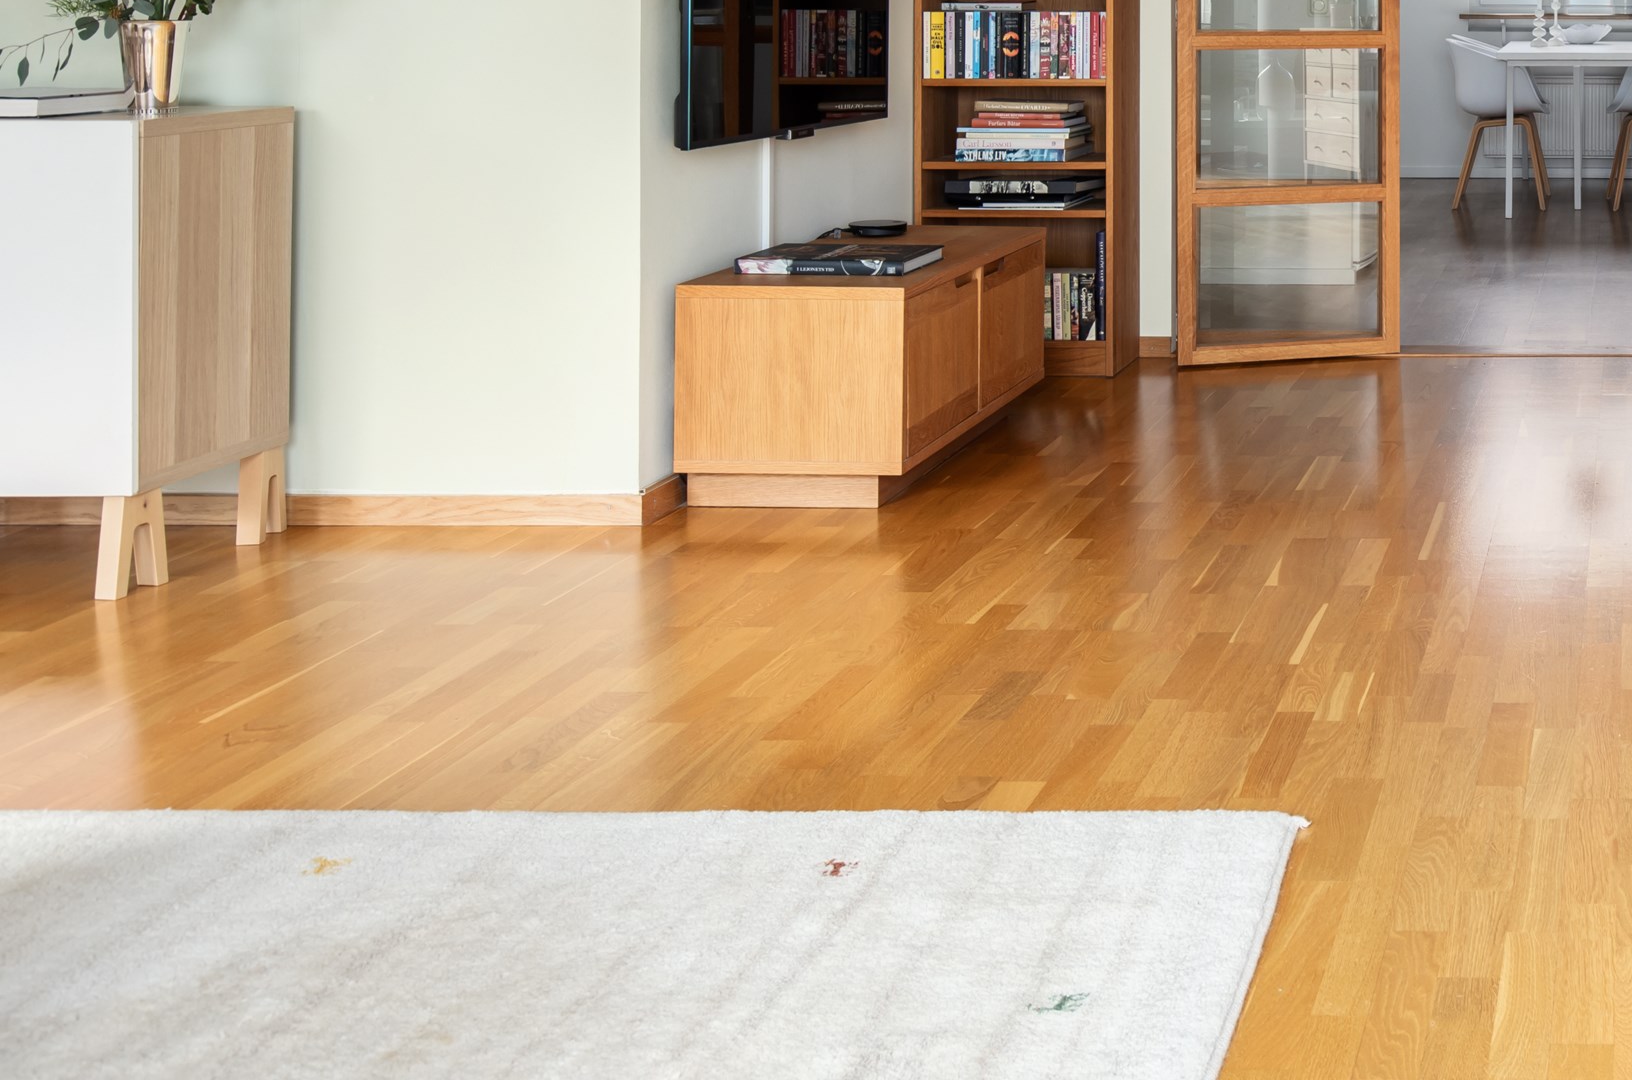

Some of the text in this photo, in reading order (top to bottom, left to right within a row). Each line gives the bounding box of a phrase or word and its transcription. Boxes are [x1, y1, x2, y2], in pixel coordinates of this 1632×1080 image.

[962, 140, 1012, 149] Carl Larsson
[963, 150, 994, 161] STHLMS
[1080, 287, 1088, 320] Copperhead
